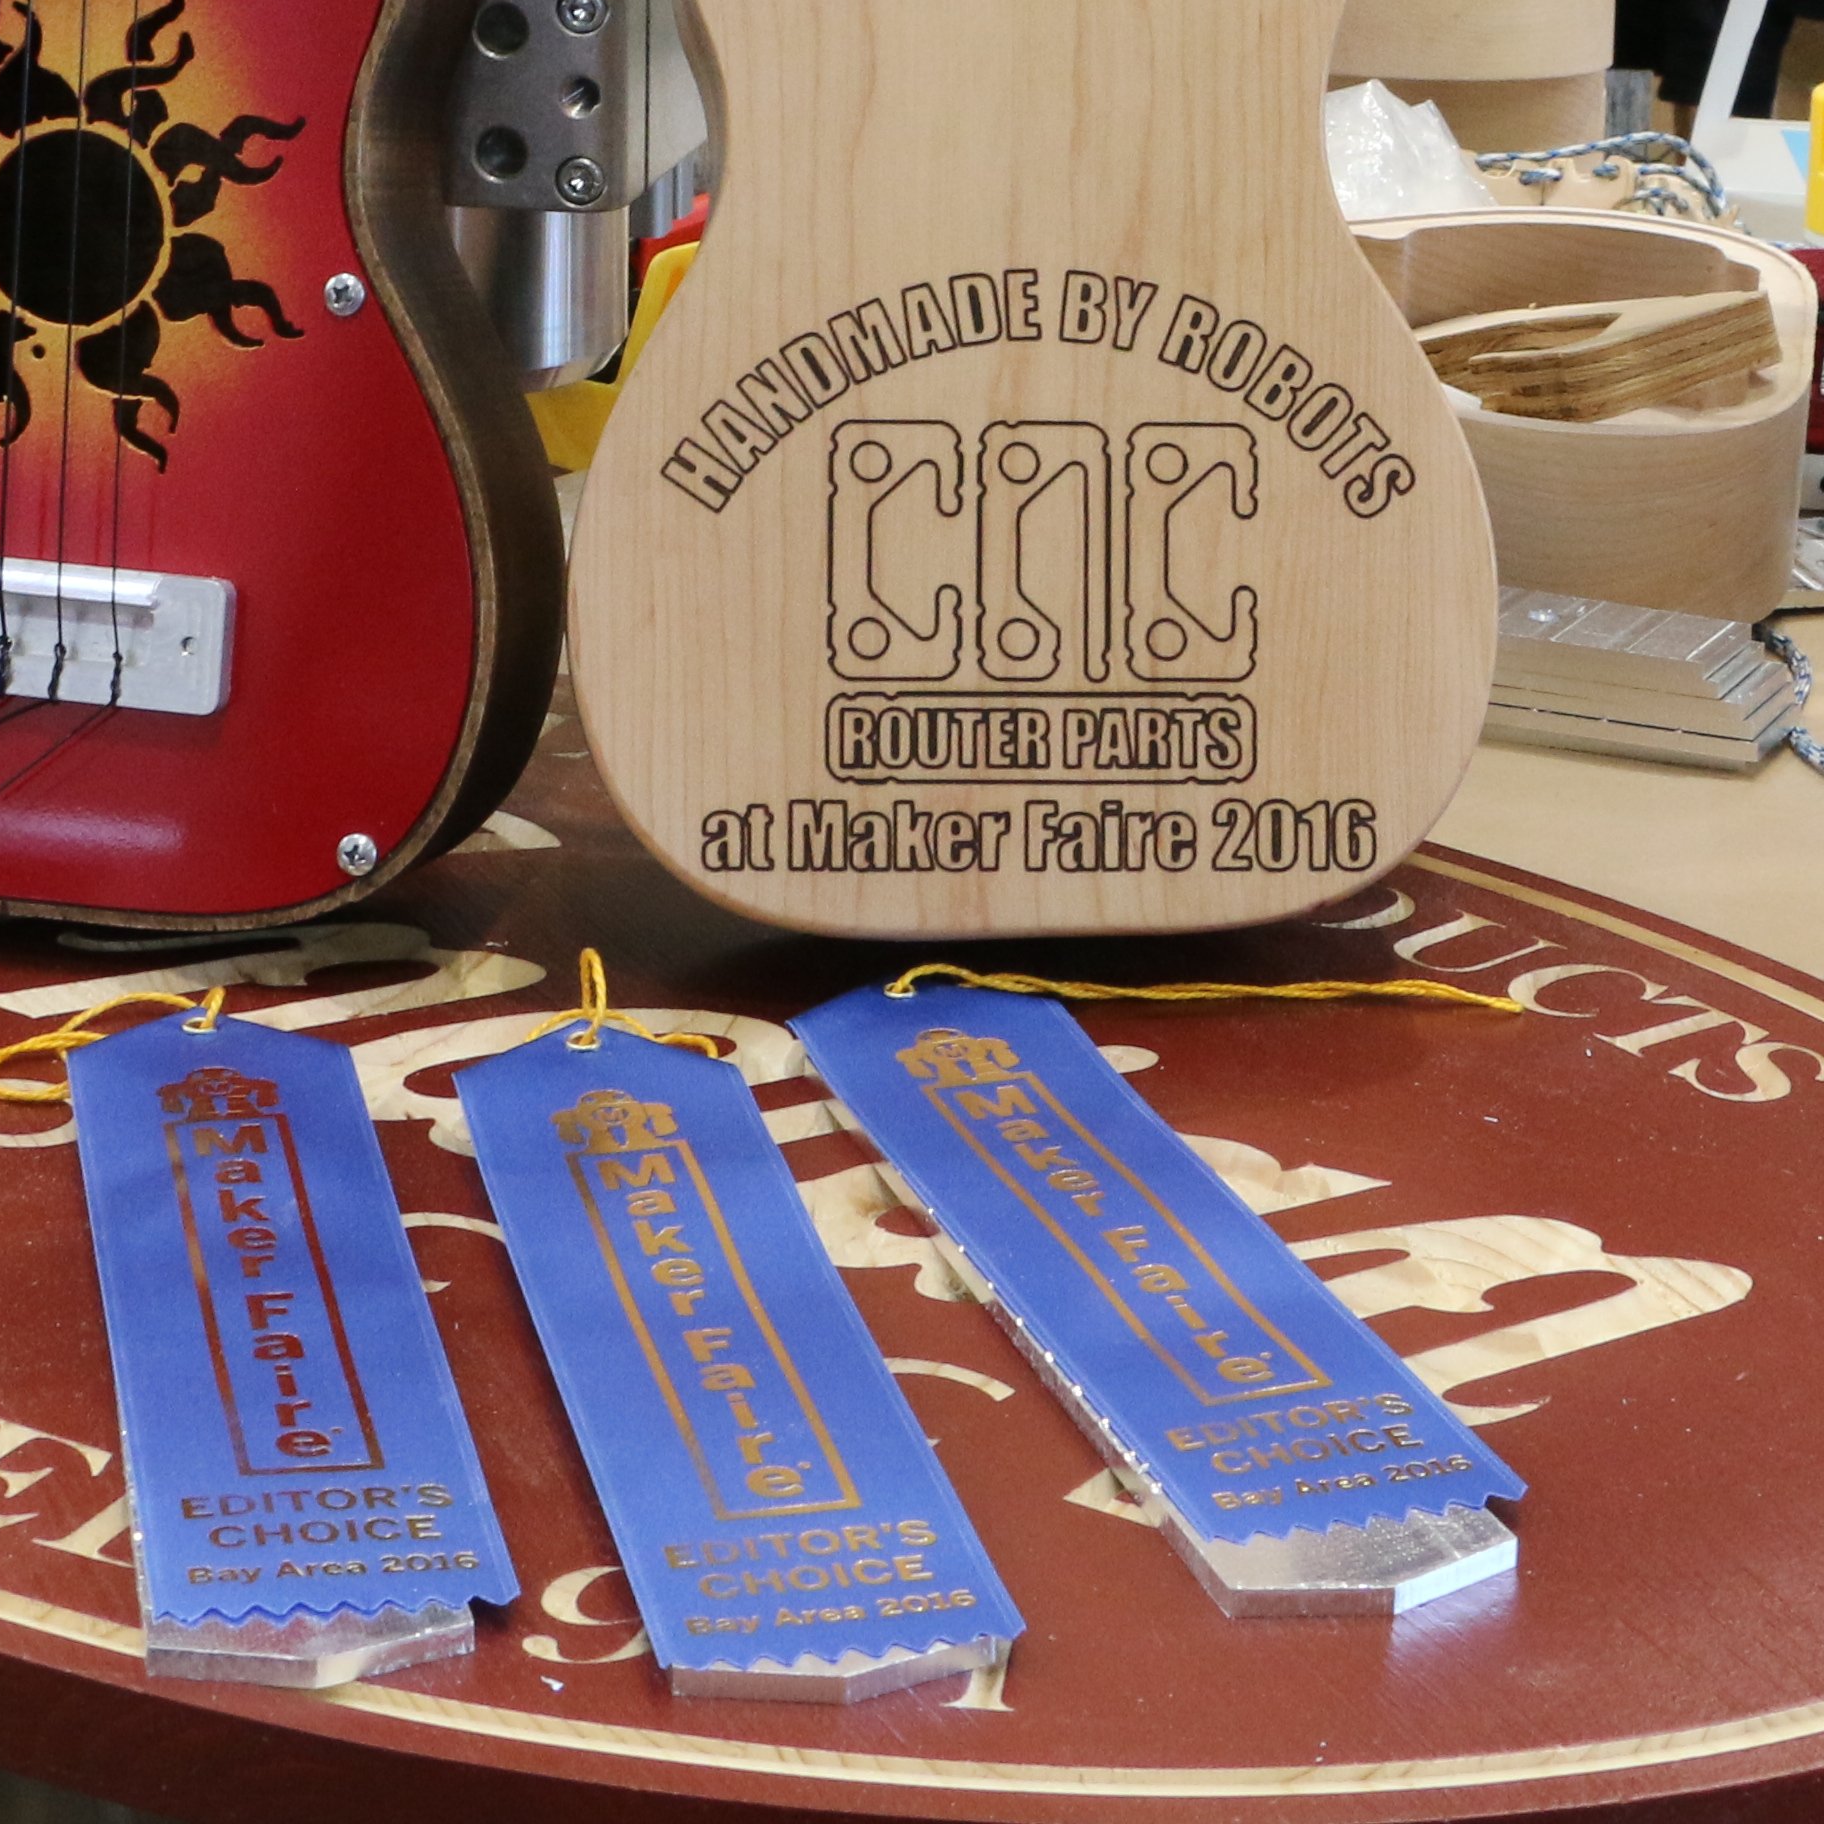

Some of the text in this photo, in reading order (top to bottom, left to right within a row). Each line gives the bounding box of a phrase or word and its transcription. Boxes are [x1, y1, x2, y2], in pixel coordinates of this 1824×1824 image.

[660, 267, 1416, 520] HANDMADE BY ROBOTS
[837, 706, 1244, 770] ROUTER PARTS
[700, 797, 1378, 874] at Maker Faire 2016
[954, 1084, 1106, 1217] Maker
[1102, 1224, 1275, 1384] Faire
[191, 1122, 333, 1459] Maker Faire
[594, 1152, 806, 1498] Maker Faire
[1163, 1392, 1414, 1452] EDITOR'S
[1210, 1422, 1425, 1475] CHOICE
[180, 1482, 454, 1521] EDITOR'S
[1210, 1453, 1474, 1511] Bay Area 2016
[208, 1514, 443, 1549] CHOICE
[662, 1519, 939, 1570] EDITOR'S
[186, 1550, 481, 1586] Bay Area 2016
[698, 1553, 935, 1600] CHOICE
[684, 1588, 977, 1637] Bay Area 2016
